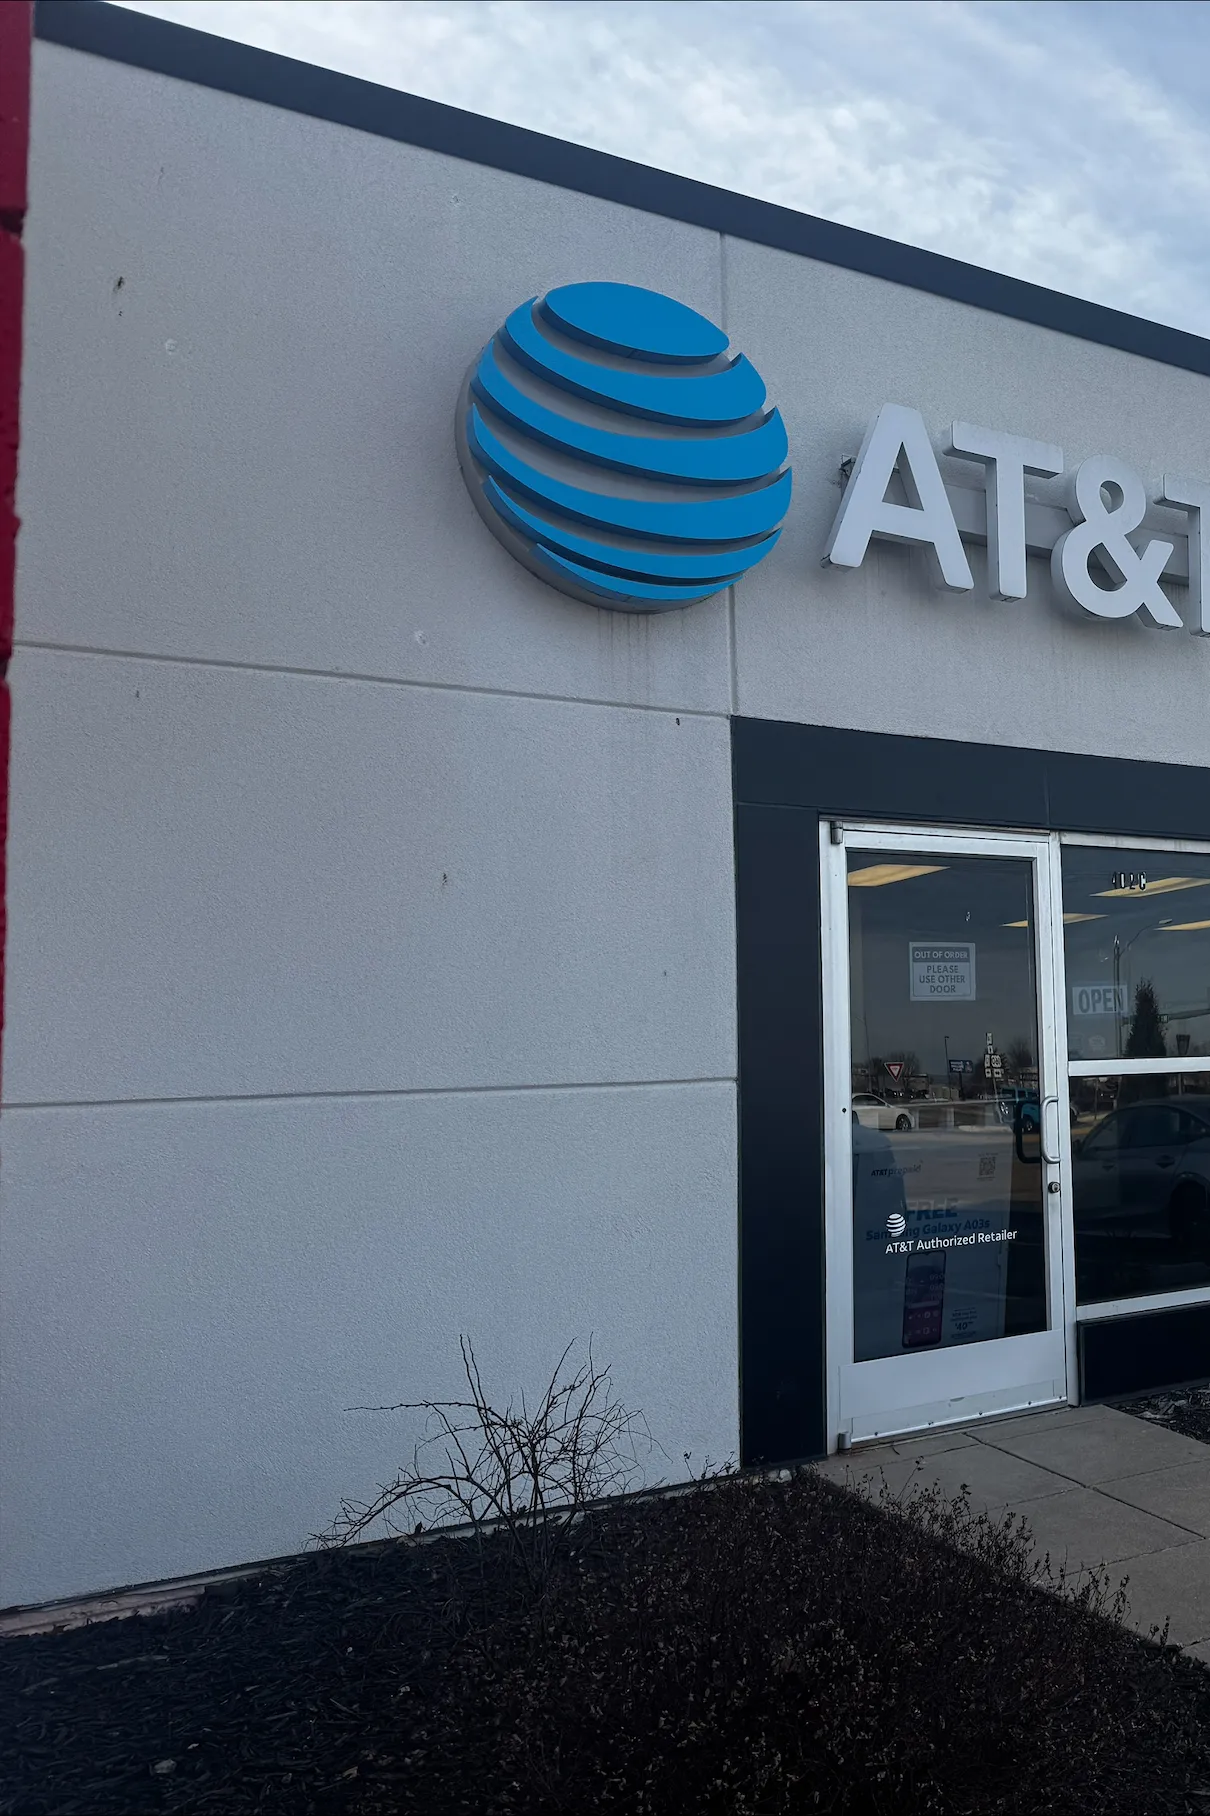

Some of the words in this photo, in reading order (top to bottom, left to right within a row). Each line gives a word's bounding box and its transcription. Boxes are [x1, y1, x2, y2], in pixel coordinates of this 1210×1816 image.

[914, 951, 931, 959] OUT
[932, 951, 943, 959] OF
[944, 951, 968, 959] ORDER
[926, 965, 959, 974] PLEASE
[919, 975, 936, 983] USE
[938, 975, 966, 984] OTHER
[930, 985, 956, 993] DOOR
[1078, 988, 1124, 1014] OPEN
[905, 1198, 958, 1221] FREE
[866, 1224, 920, 1240] Samng
[923, 1220, 962, 1235] Galaxy
[964, 1219, 990, 1230] A03s
[885, 1240, 914, 1254] AT&T
[916, 1233, 976, 1251] Authorized
[978, 1229, 1018, 1243] Retailer
